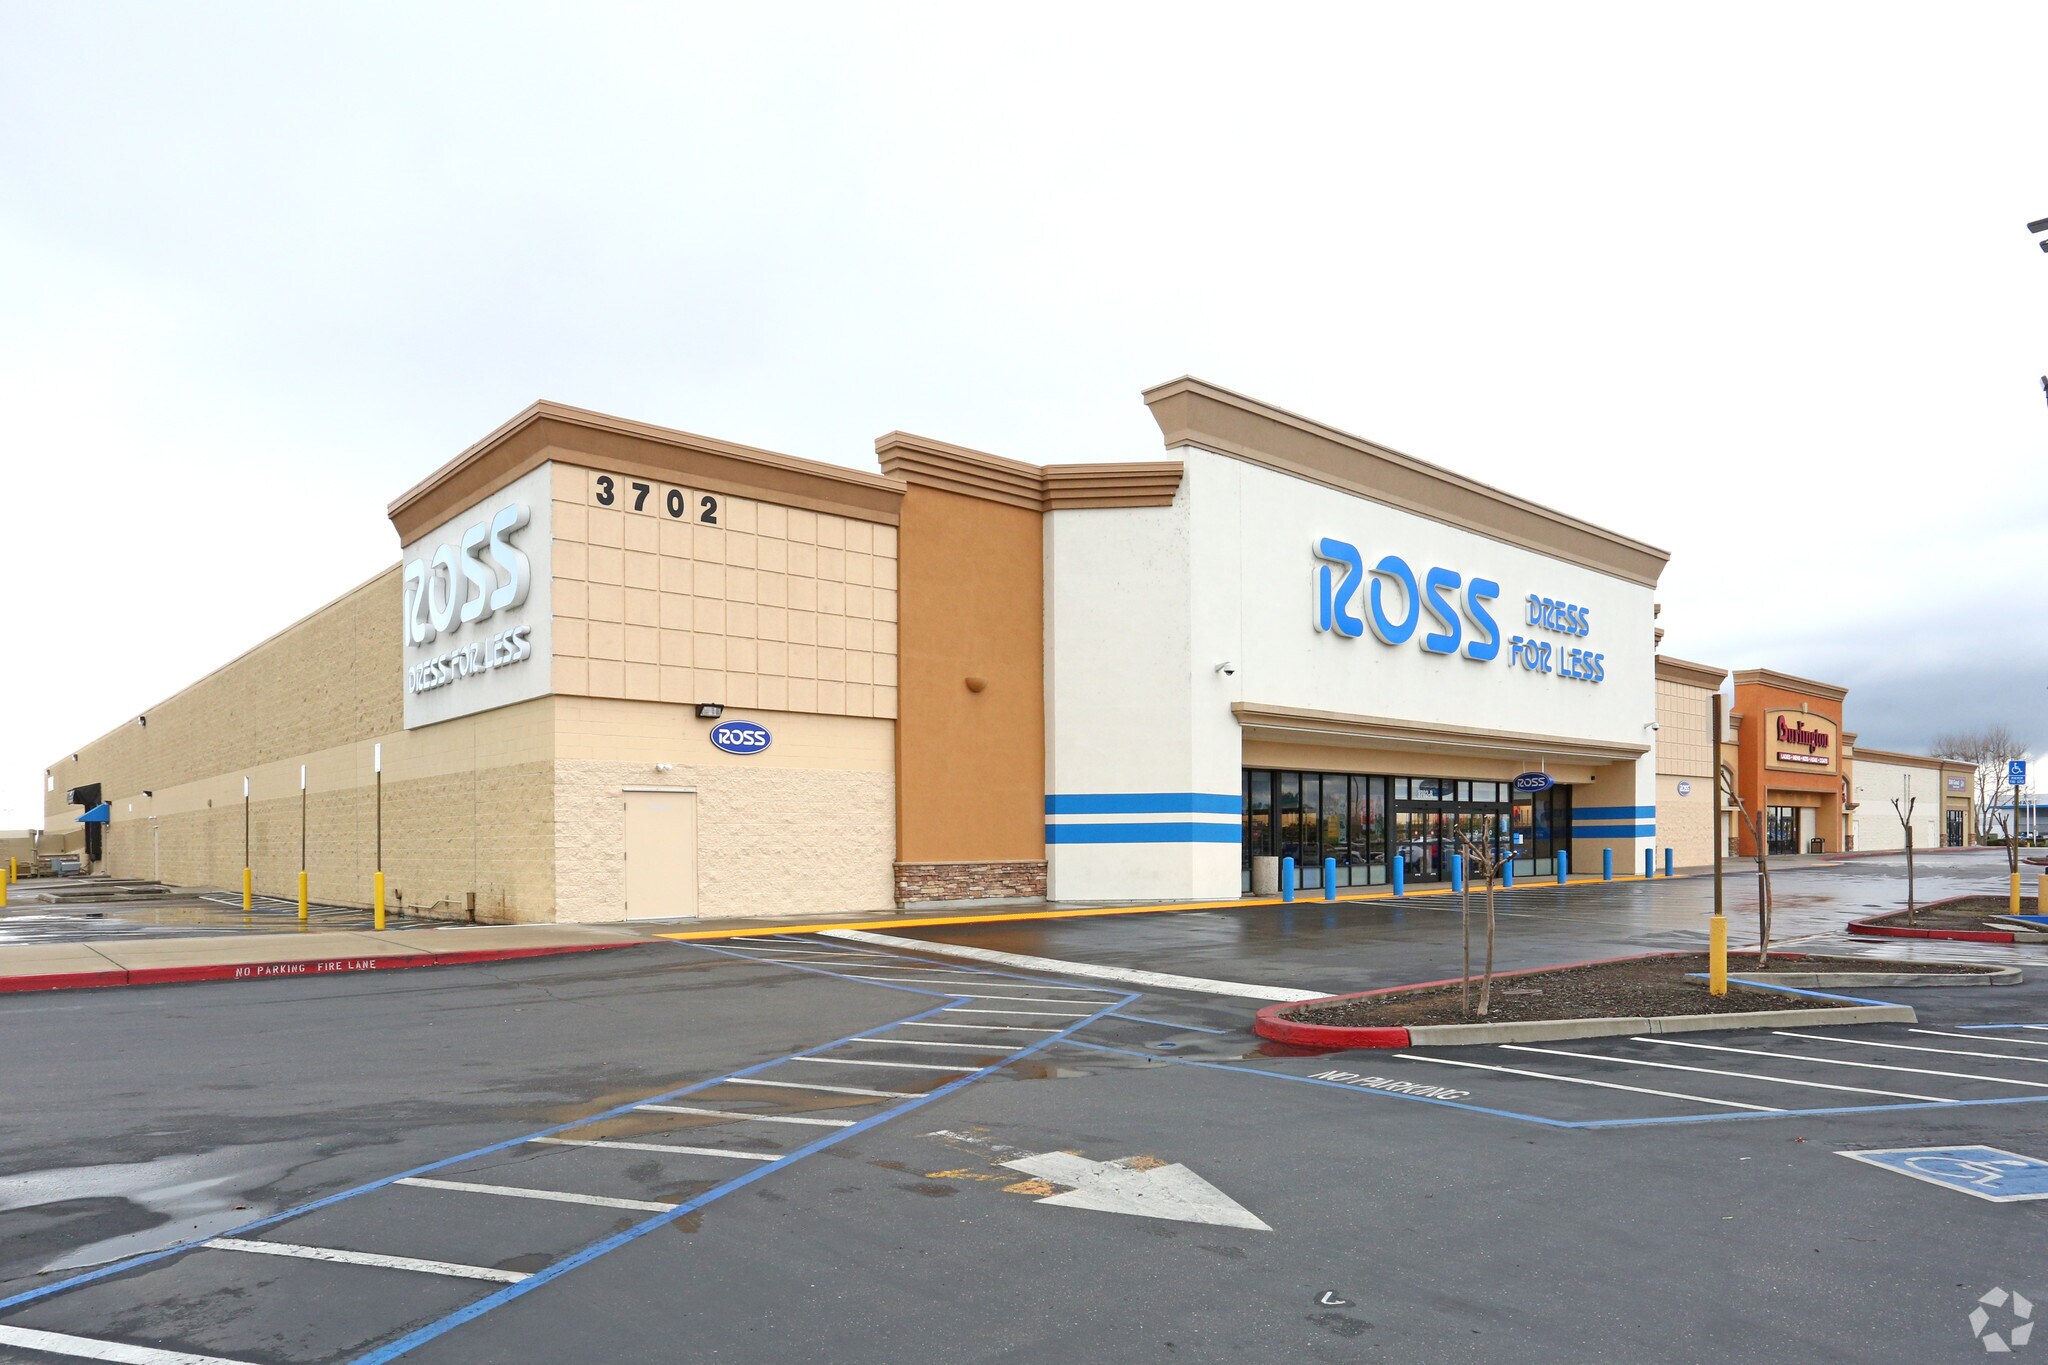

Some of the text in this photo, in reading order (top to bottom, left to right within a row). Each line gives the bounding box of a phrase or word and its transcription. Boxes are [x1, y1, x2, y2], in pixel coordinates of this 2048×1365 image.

[596, 475, 718, 525] 3702
[404, 503, 531, 648] ROSS
[1311, 537, 1501, 662] ROSS
[1526, 593, 1590, 637] DRESS
[408, 625, 531, 695] DRESS FOR LESS
[1508, 635, 1605, 683] FOR LESS
[718, 728, 766, 746] ROSS
[1777, 714, 1829, 754] Burlington
[1517, 777, 1546, 788] ROSS
[235, 959, 377, 978] NO PARKING FIRE LANE
[1307, 1070, 1471, 1101] NO PARKING
